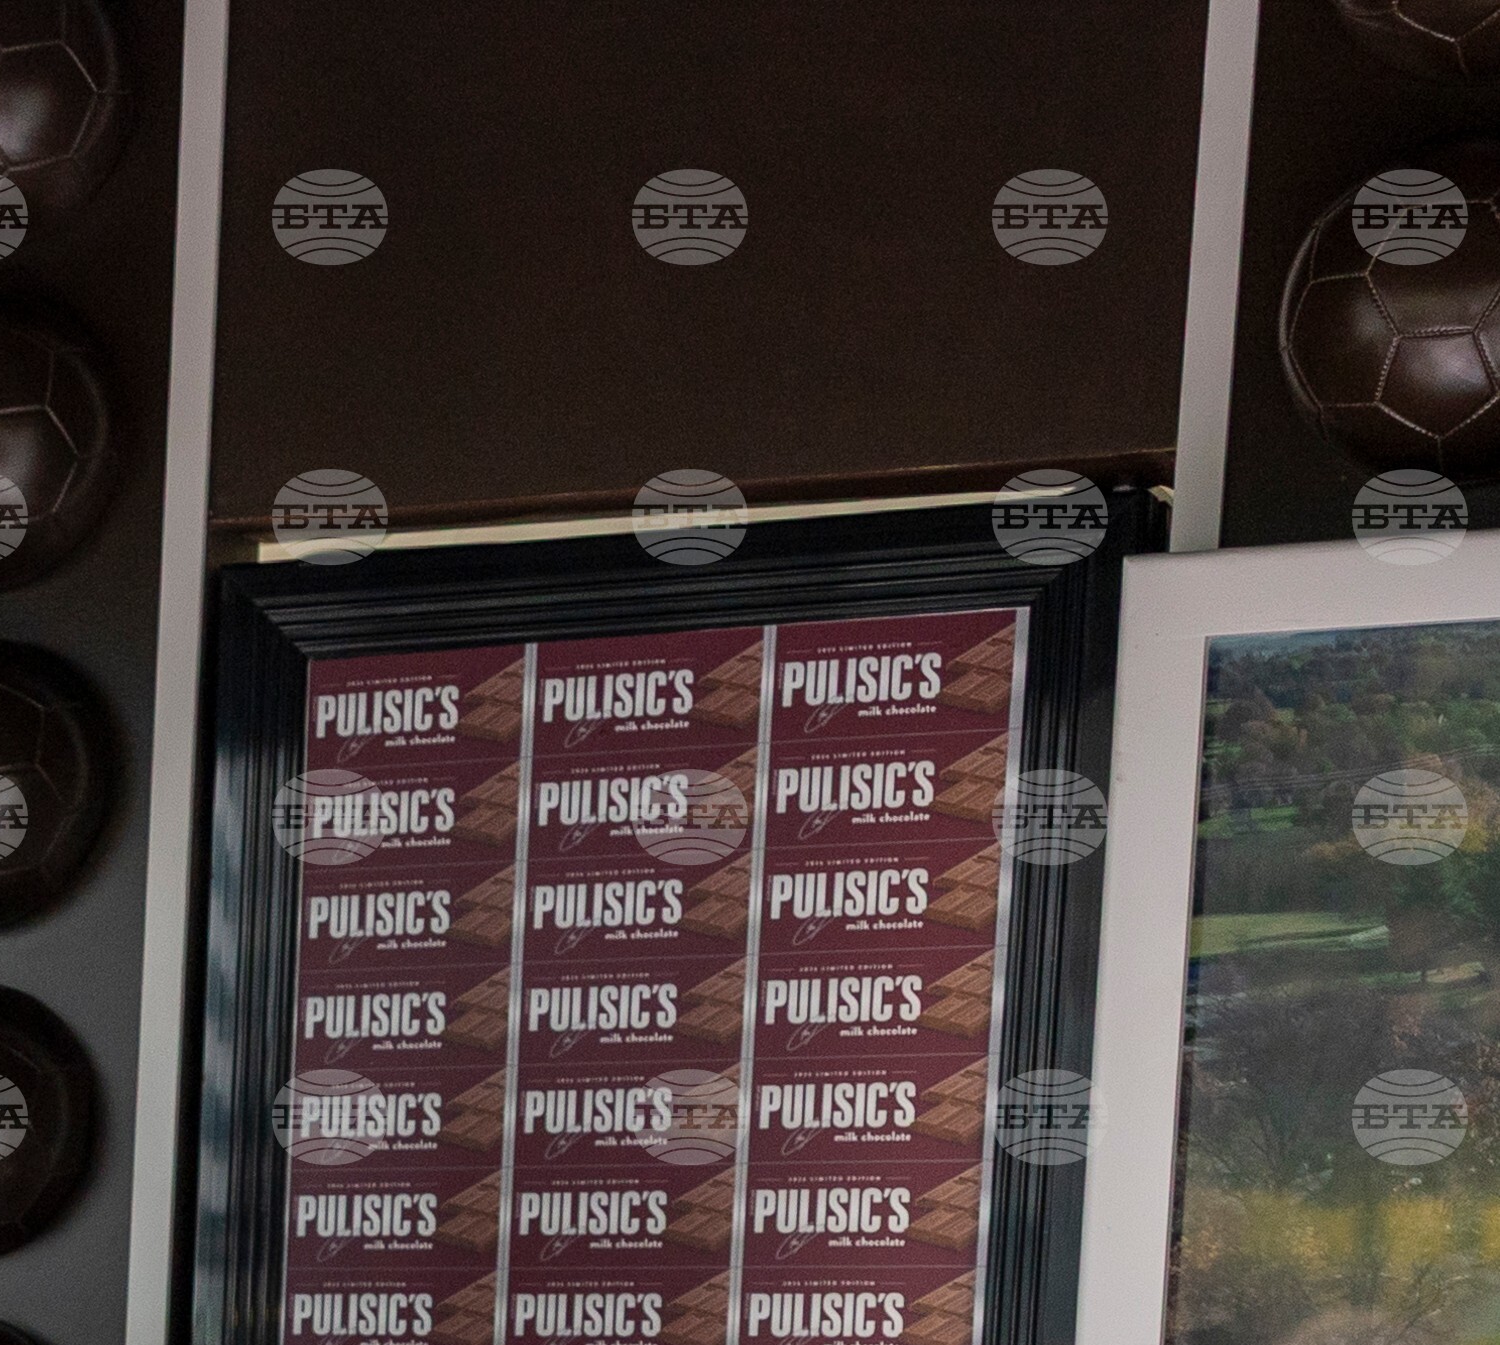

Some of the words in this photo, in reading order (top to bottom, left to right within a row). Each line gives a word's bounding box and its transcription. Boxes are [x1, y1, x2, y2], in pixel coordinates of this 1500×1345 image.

[542, 670, 695, 723] PULISIC'S
[782, 652, 943, 706] PULISIC'S
[316, 686, 460, 739] PULISIC'S
[614, 721, 639, 733] milk
[640, 718, 691, 731] chocolate
[858, 706, 883, 718] milk
[885, 703, 937, 716] chocolate
[538, 775, 689, 826] PULISIC'S
[776, 761, 936, 813] PULISIC'S
[313, 788, 456, 840] PULISIC'S
[851, 813, 877, 825] milk
[879, 810, 931, 823] chocolate
[308, 890, 451, 939] PULISIC'S
[533, 879, 683, 930] PULISIC'S
[770, 869, 929, 920] PULISIC'S
[845, 920, 870, 931] milk
[872, 918, 925, 931] chocolate
[305, 992, 446, 1040] PULISIC'S
[529, 983, 678, 1033] PULISIC'S
[765, 975, 922, 1026] PULISIC'S
[599, 1033, 623, 1044] milk
[625, 1032, 674, 1043] chocolate
[839, 1026, 865, 1037] milk
[866, 1025, 919, 1037] chocolate
[301, 1092, 441, 1139] PULISIC'S
[524, 1088, 673, 1135] PULISIC'S
[759, 1082, 917, 1131] PULISIC'S
[834, 1132, 859, 1143] milk
[860, 1130, 912, 1143] chocolate
[296, 1193, 437, 1238] PULISIC'S
[519, 1191, 667, 1237] PULISIC'S
[753, 1188, 910, 1235] PULISIC'S
[590, 1238, 613, 1249] milk
[615, 1238, 664, 1249] chocolate
[828, 1236, 853, 1247] milk
[855, 1236, 906, 1247] chocolate
[293, 1294, 433, 1337] PULISIC'S
[514, 1294, 662, 1337] PULISIC'S
[748, 1294, 905, 1339] PULISIC'S
